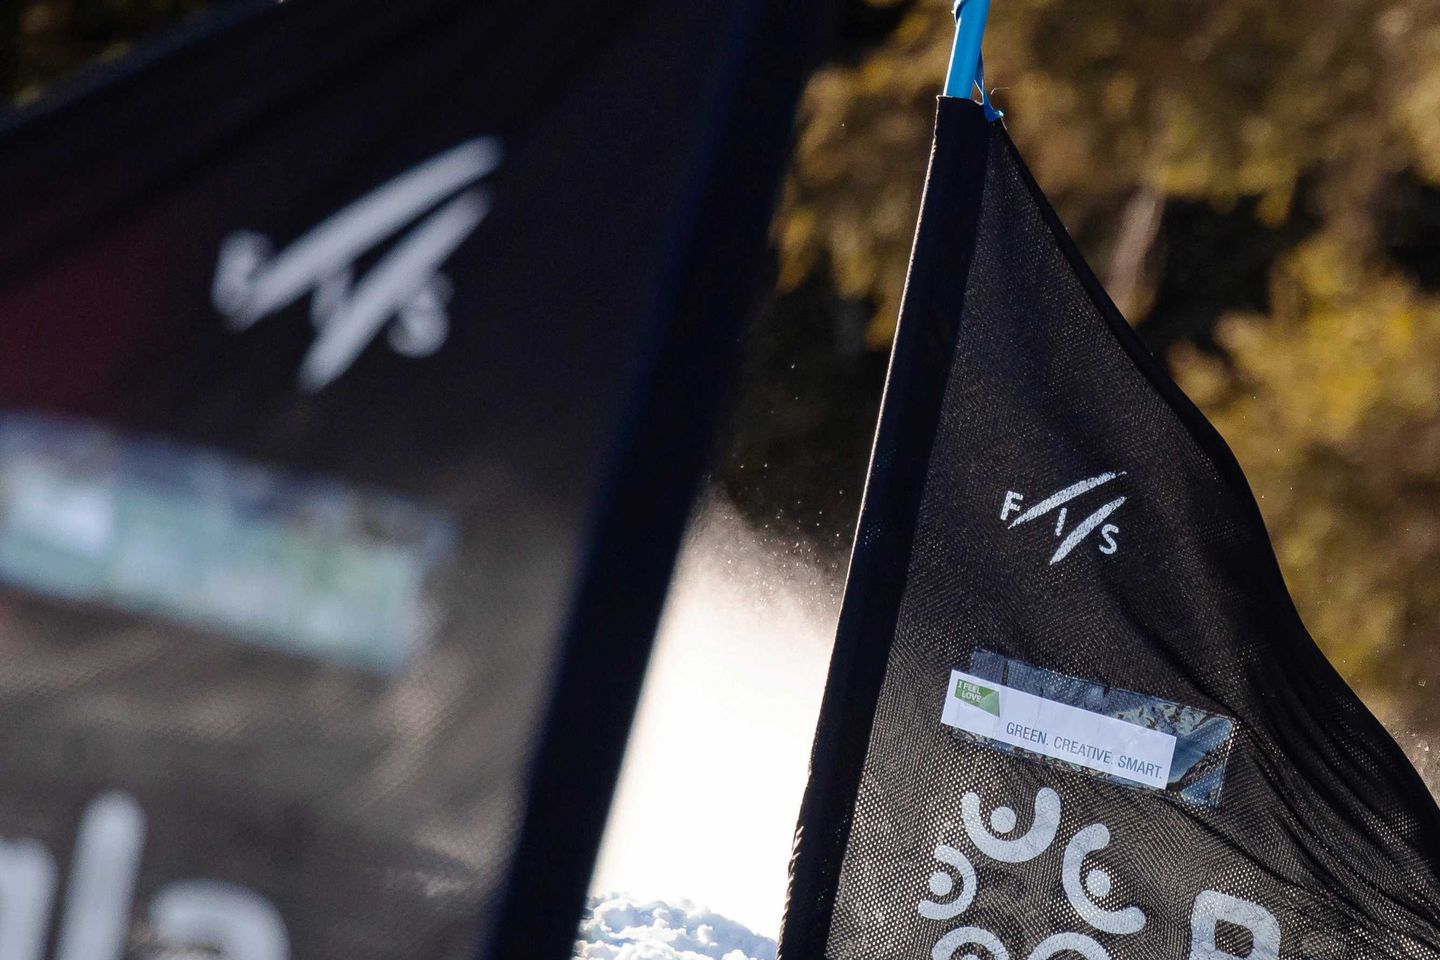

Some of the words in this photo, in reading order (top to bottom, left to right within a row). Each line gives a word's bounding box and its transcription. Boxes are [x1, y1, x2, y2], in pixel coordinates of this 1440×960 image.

[1000, 490, 1119, 555] FIS
[1006, 722, 1049, 746] GREEN.
[1053, 736, 1114, 766] CREATIVE.
[1117, 754, 1163, 780] SMART.
